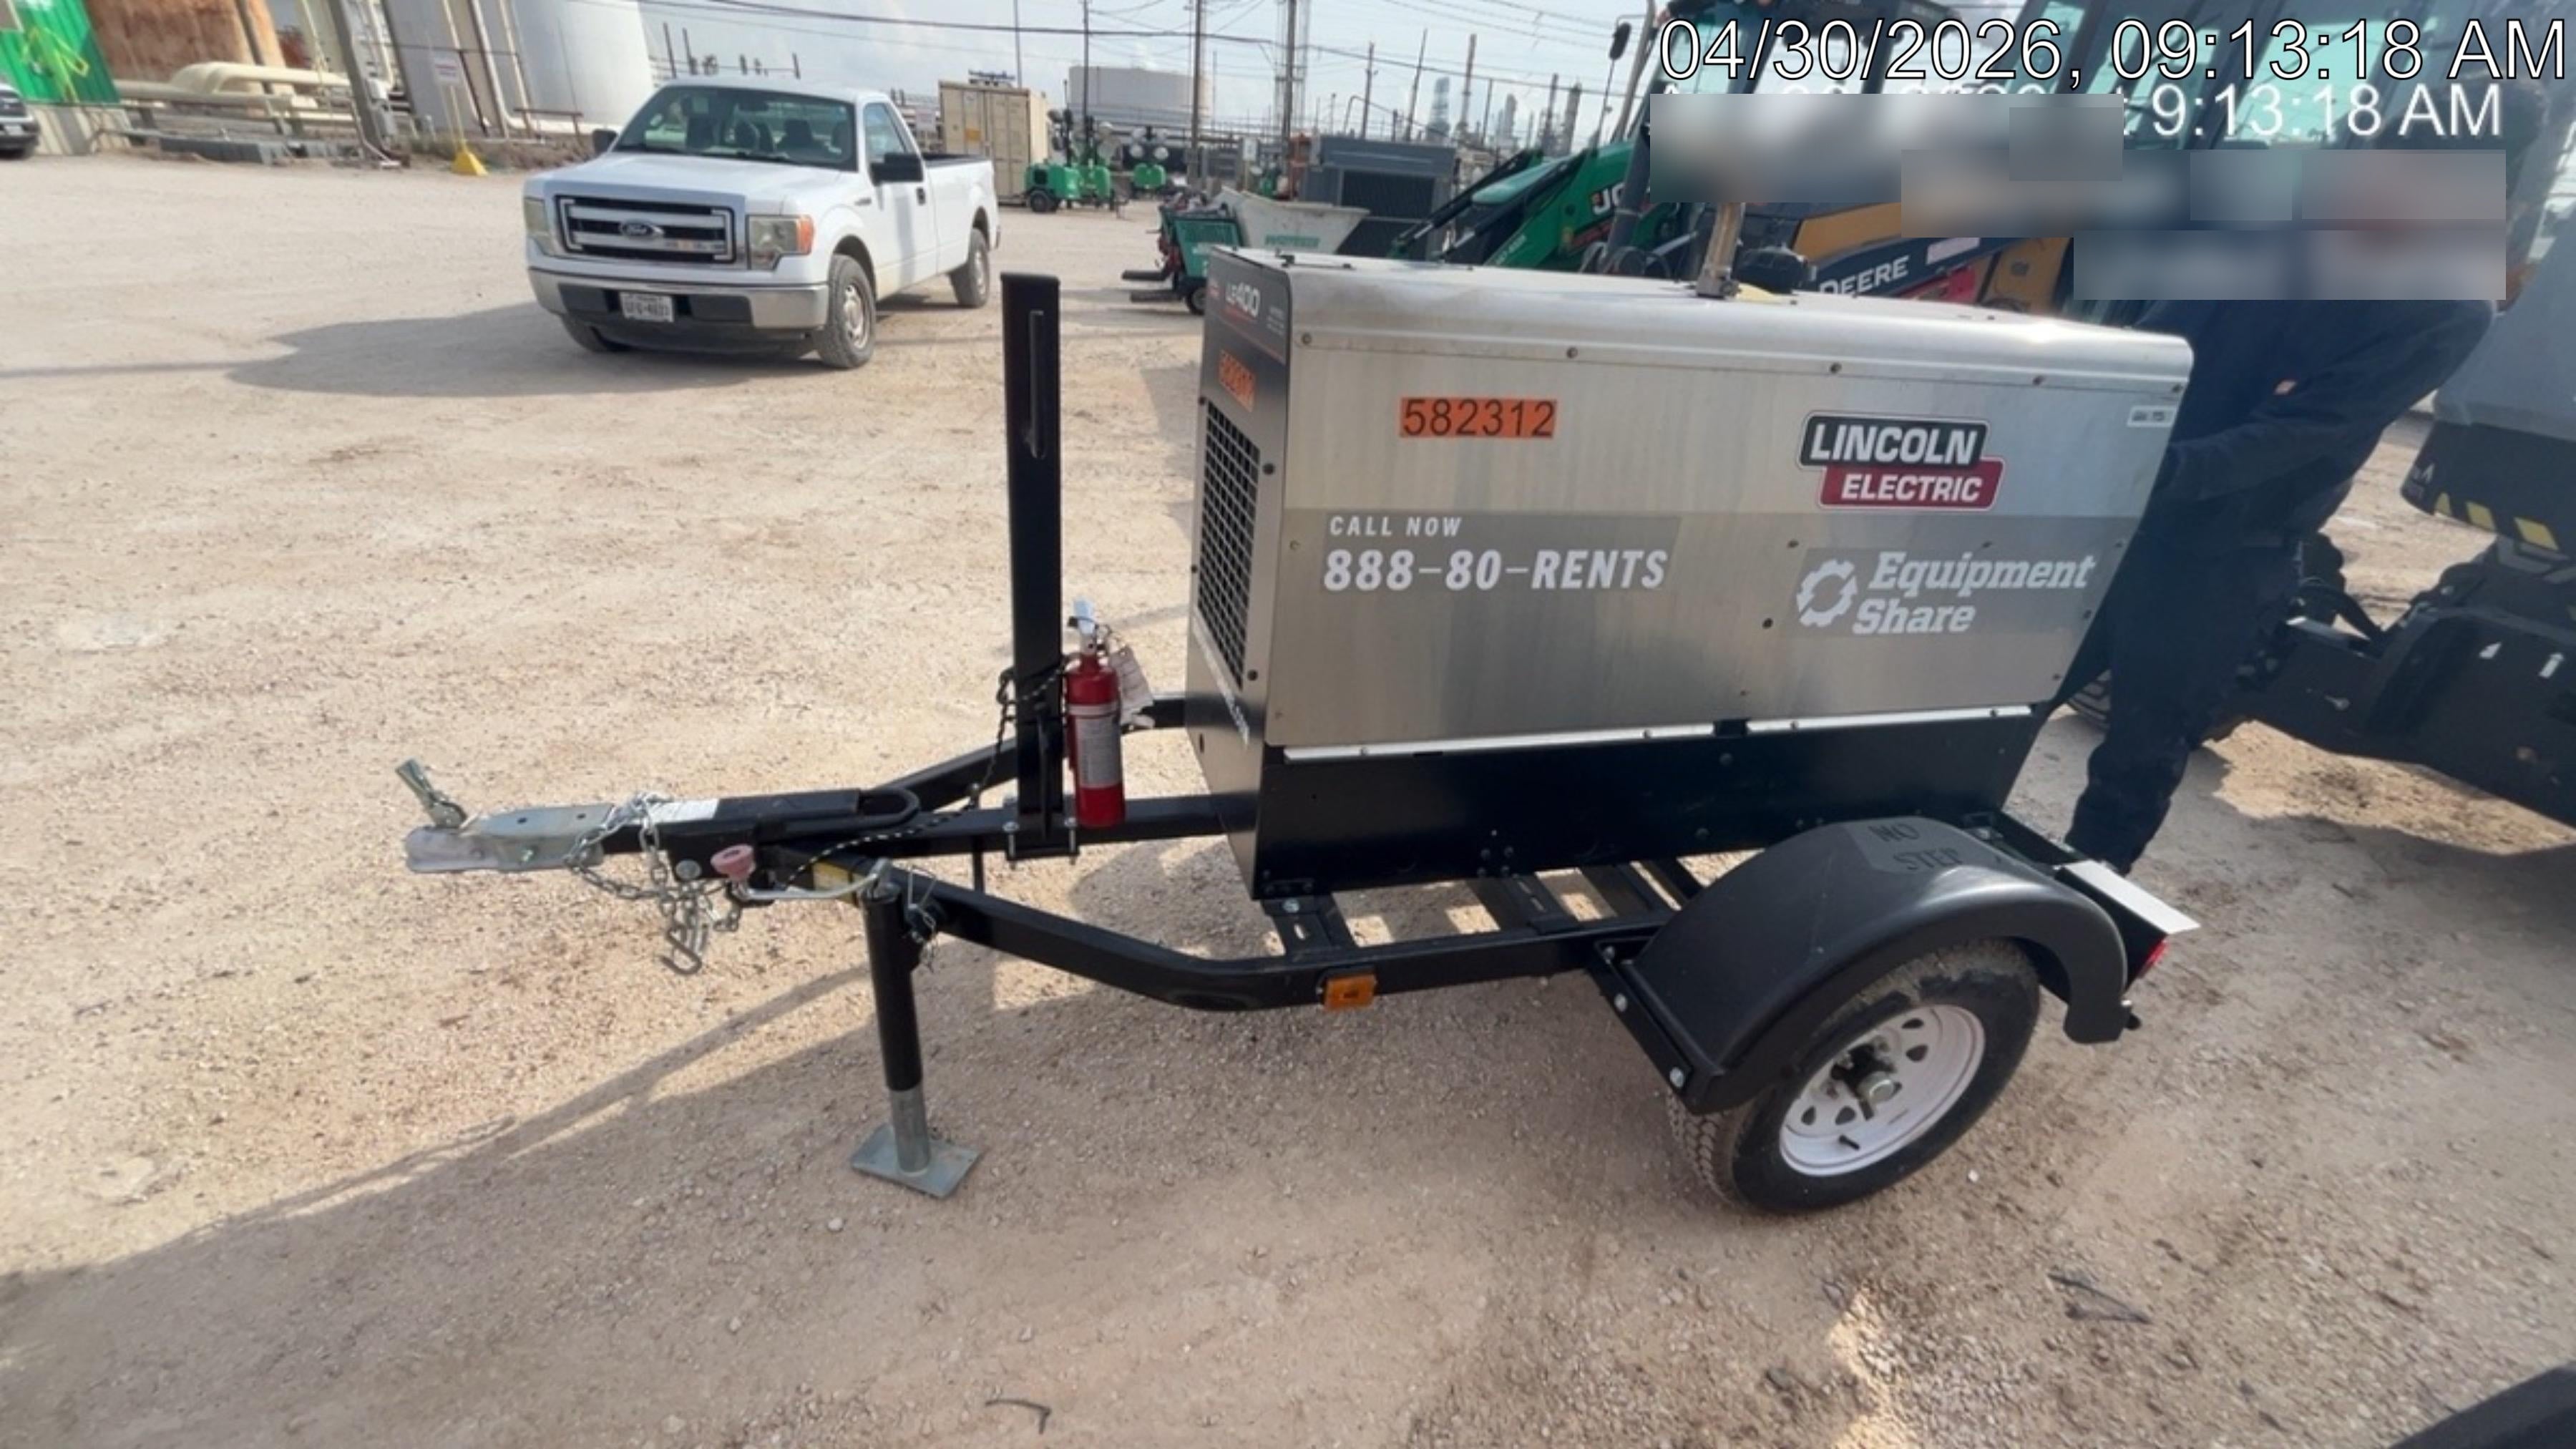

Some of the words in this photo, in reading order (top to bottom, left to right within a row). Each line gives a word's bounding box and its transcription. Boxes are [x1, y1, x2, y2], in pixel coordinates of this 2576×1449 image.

[1818, 255, 1910, 295] DEERE
[1403, 398, 1555, 436] 582312
[1810, 423, 1978, 465] LINCOLN
[1840, 474, 1983, 502] ELECTRIC
[1330, 516, 1392, 537] CALL
[1406, 517, 1462, 537] NOW
[1324, 549, 1669, 591] 888-80-RENTS
[1868, 551, 2097, 598] Equipment
[1852, 598, 1976, 635] Share
[1868, 823, 1921, 842] NO
[1893, 847, 1963, 871] STEP
